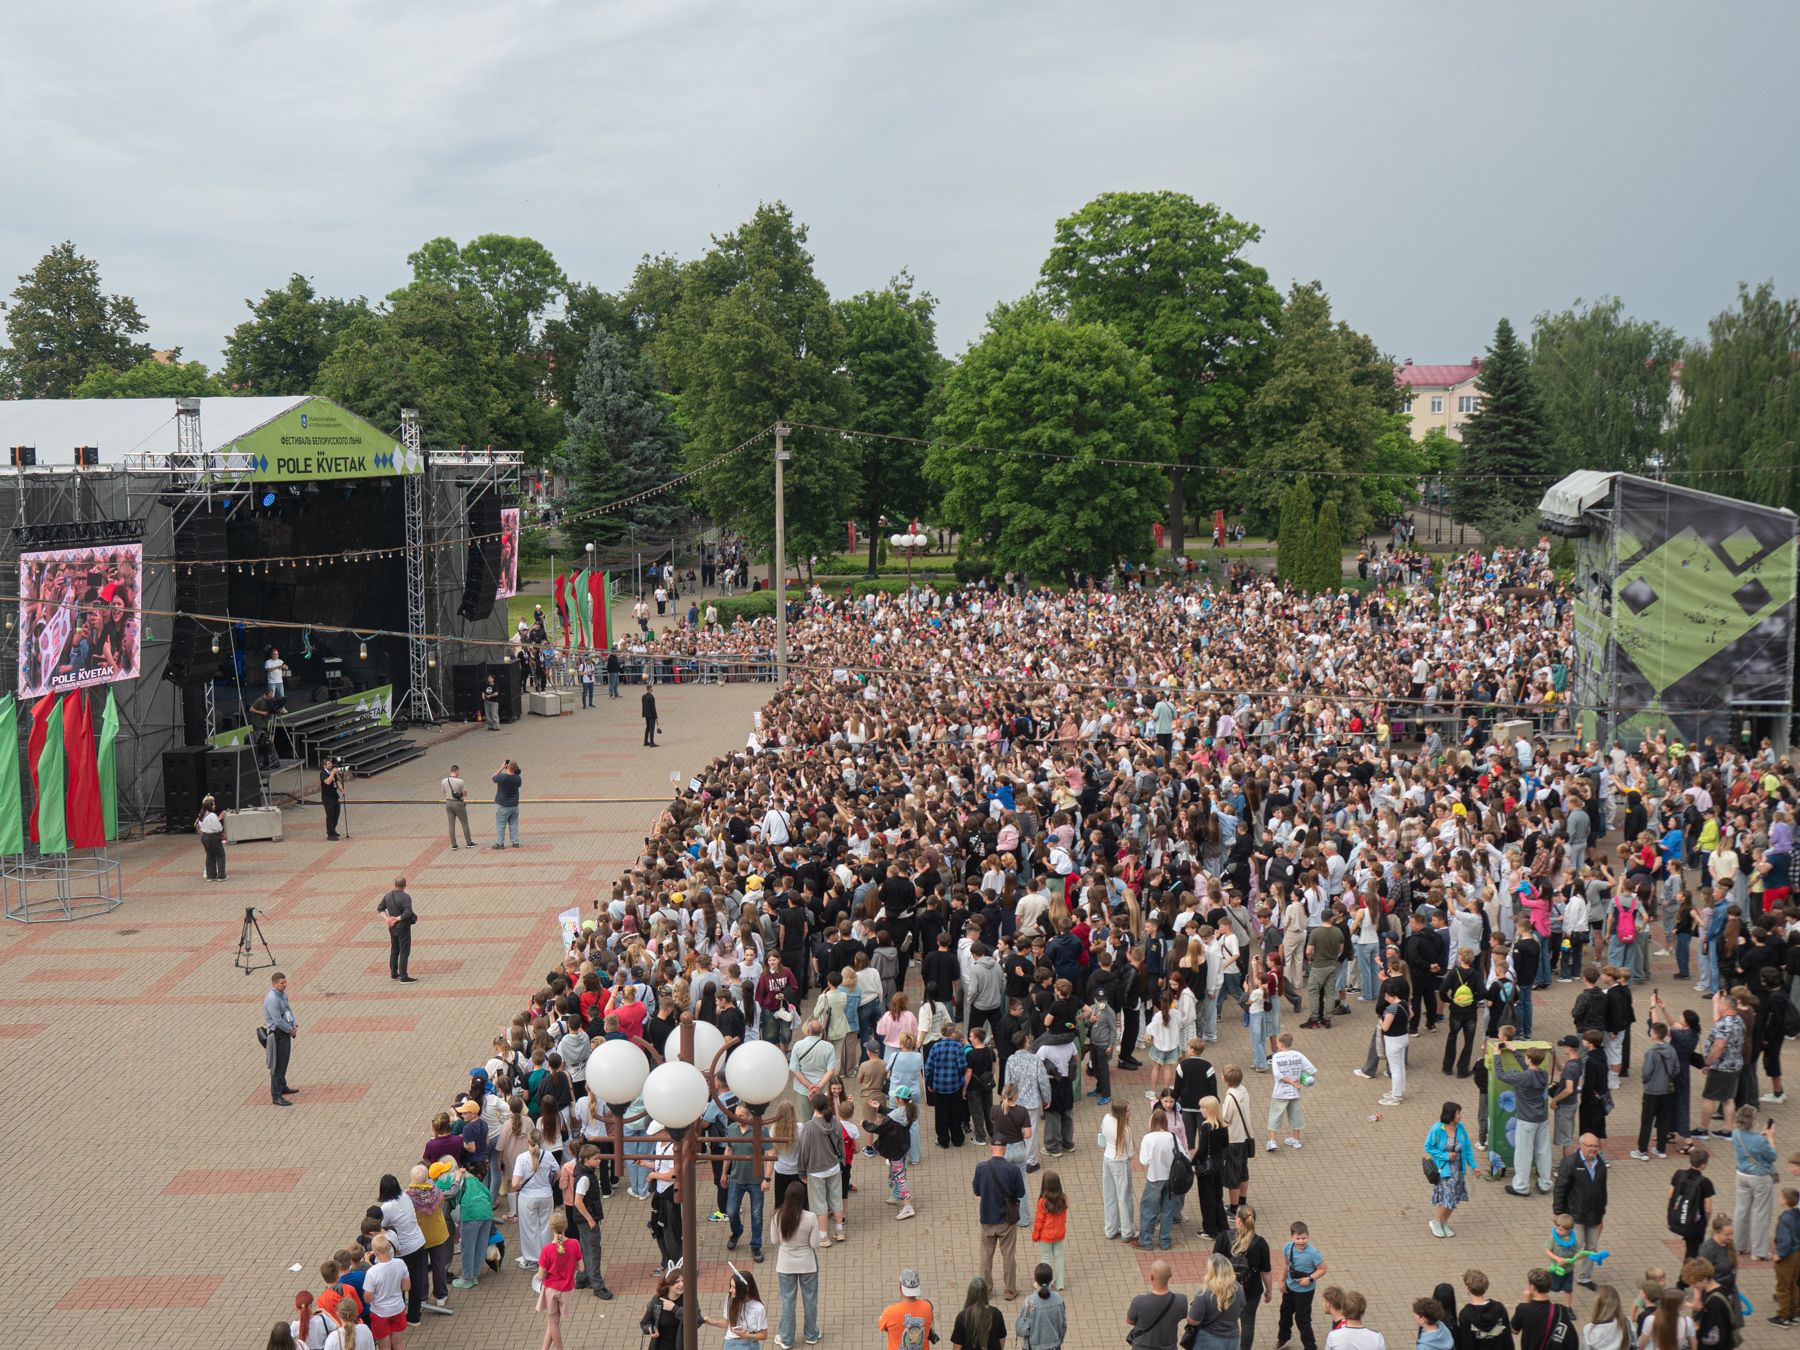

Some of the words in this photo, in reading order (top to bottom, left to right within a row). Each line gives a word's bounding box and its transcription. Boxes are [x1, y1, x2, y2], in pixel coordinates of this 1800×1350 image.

[281, 436, 311, 445] ФЕСТИВАЛЬ
[312, 436, 348, 445] БЕЛОРУССКОГО
[277, 457, 312, 474] POLE
[316, 455, 367, 474] KVETAK
[52, 672, 77, 686] POLE
[78, 666, 113, 680] KVETAK
